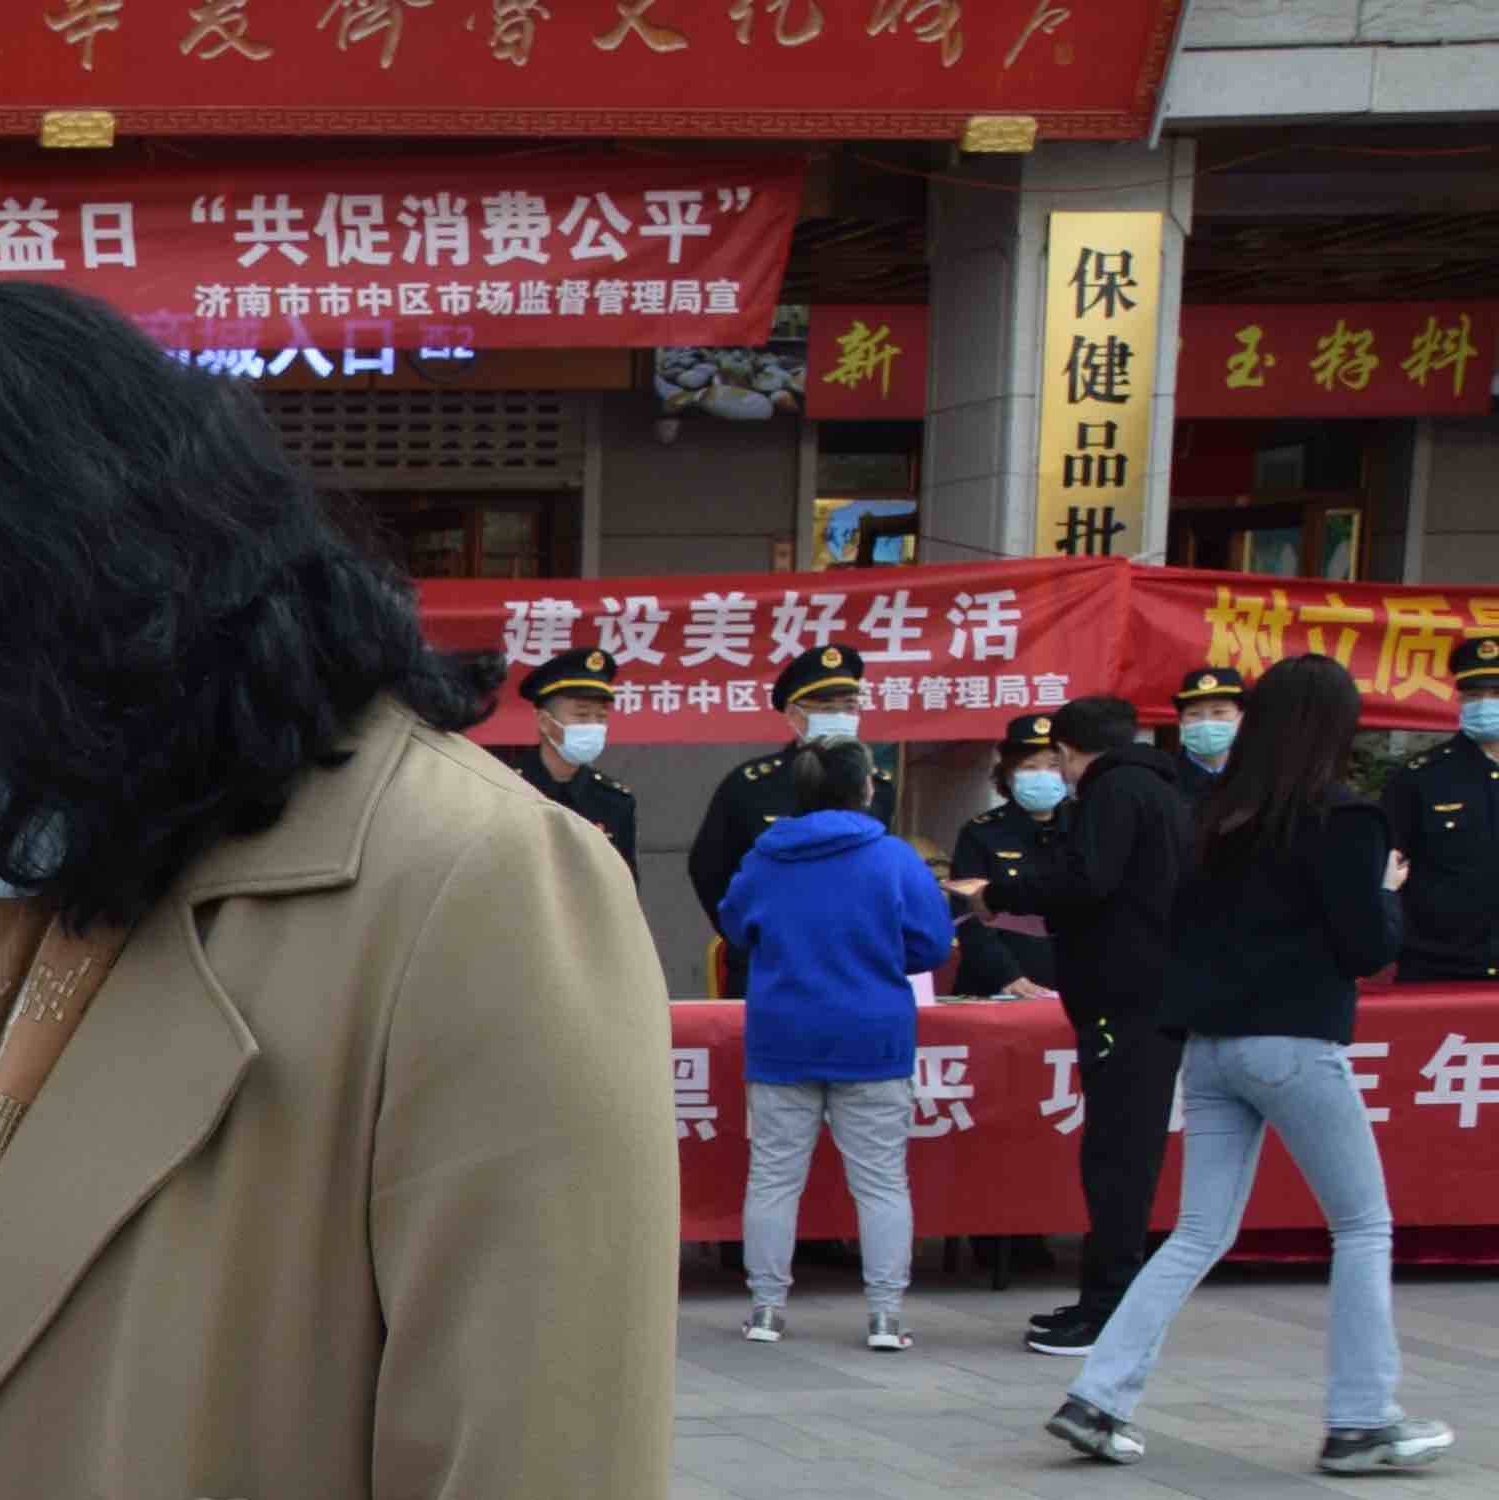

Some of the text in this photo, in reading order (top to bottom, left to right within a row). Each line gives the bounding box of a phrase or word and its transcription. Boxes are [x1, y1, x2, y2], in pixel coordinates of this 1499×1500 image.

[194, 279, 740, 317] 济南市市中区市场监督管理局宣
[822, 319, 902, 398] 新
[503, 589, 1023, 668] 建设美好生活
